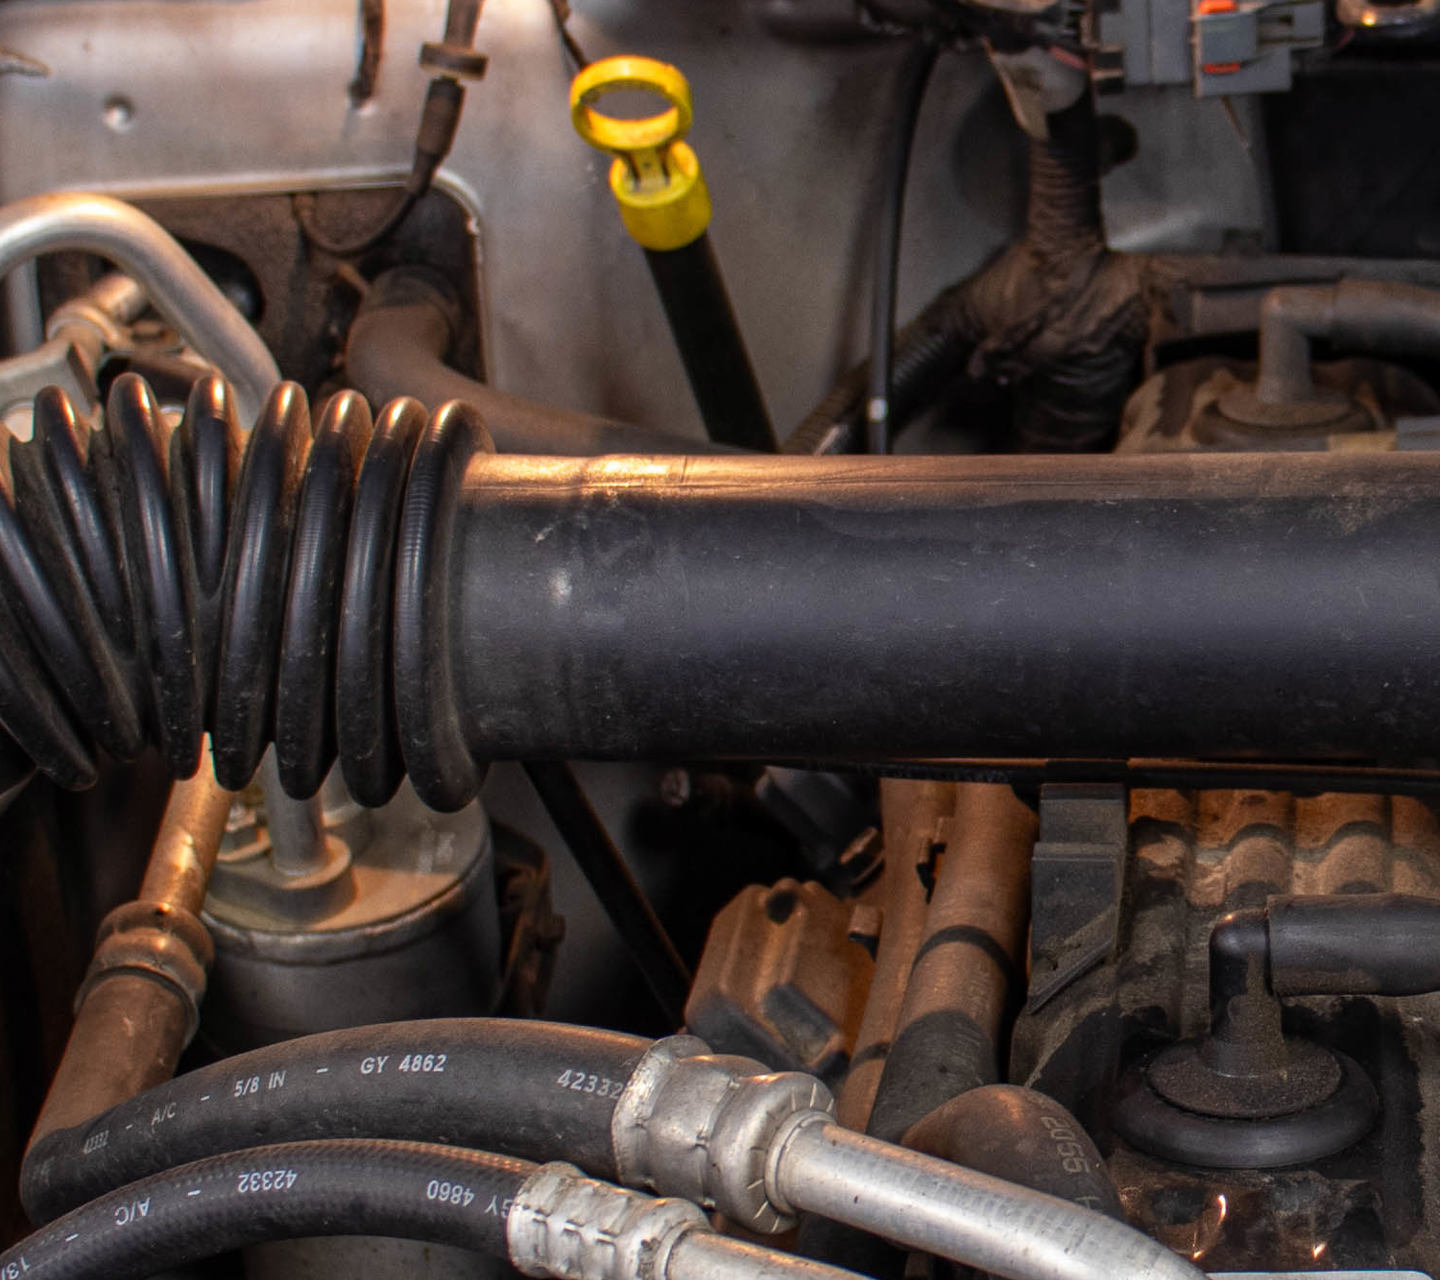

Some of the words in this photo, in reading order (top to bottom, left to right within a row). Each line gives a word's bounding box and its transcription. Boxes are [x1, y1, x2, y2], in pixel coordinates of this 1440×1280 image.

[151, 1101, 177, 1126] A/C
[233, 1075, 260, 1098] 5/8
[268, 1070, 287, 1090] IN
[360, 1055, 387, 1076] GY
[398, 1053, 448, 1073] 4862
[556, 1068, 624, 1100] 42332
[238, 1169, 299, 1193] 42332
[426, 1178, 476, 1205] 4860
[114, 1196, 152, 1227] A/C
